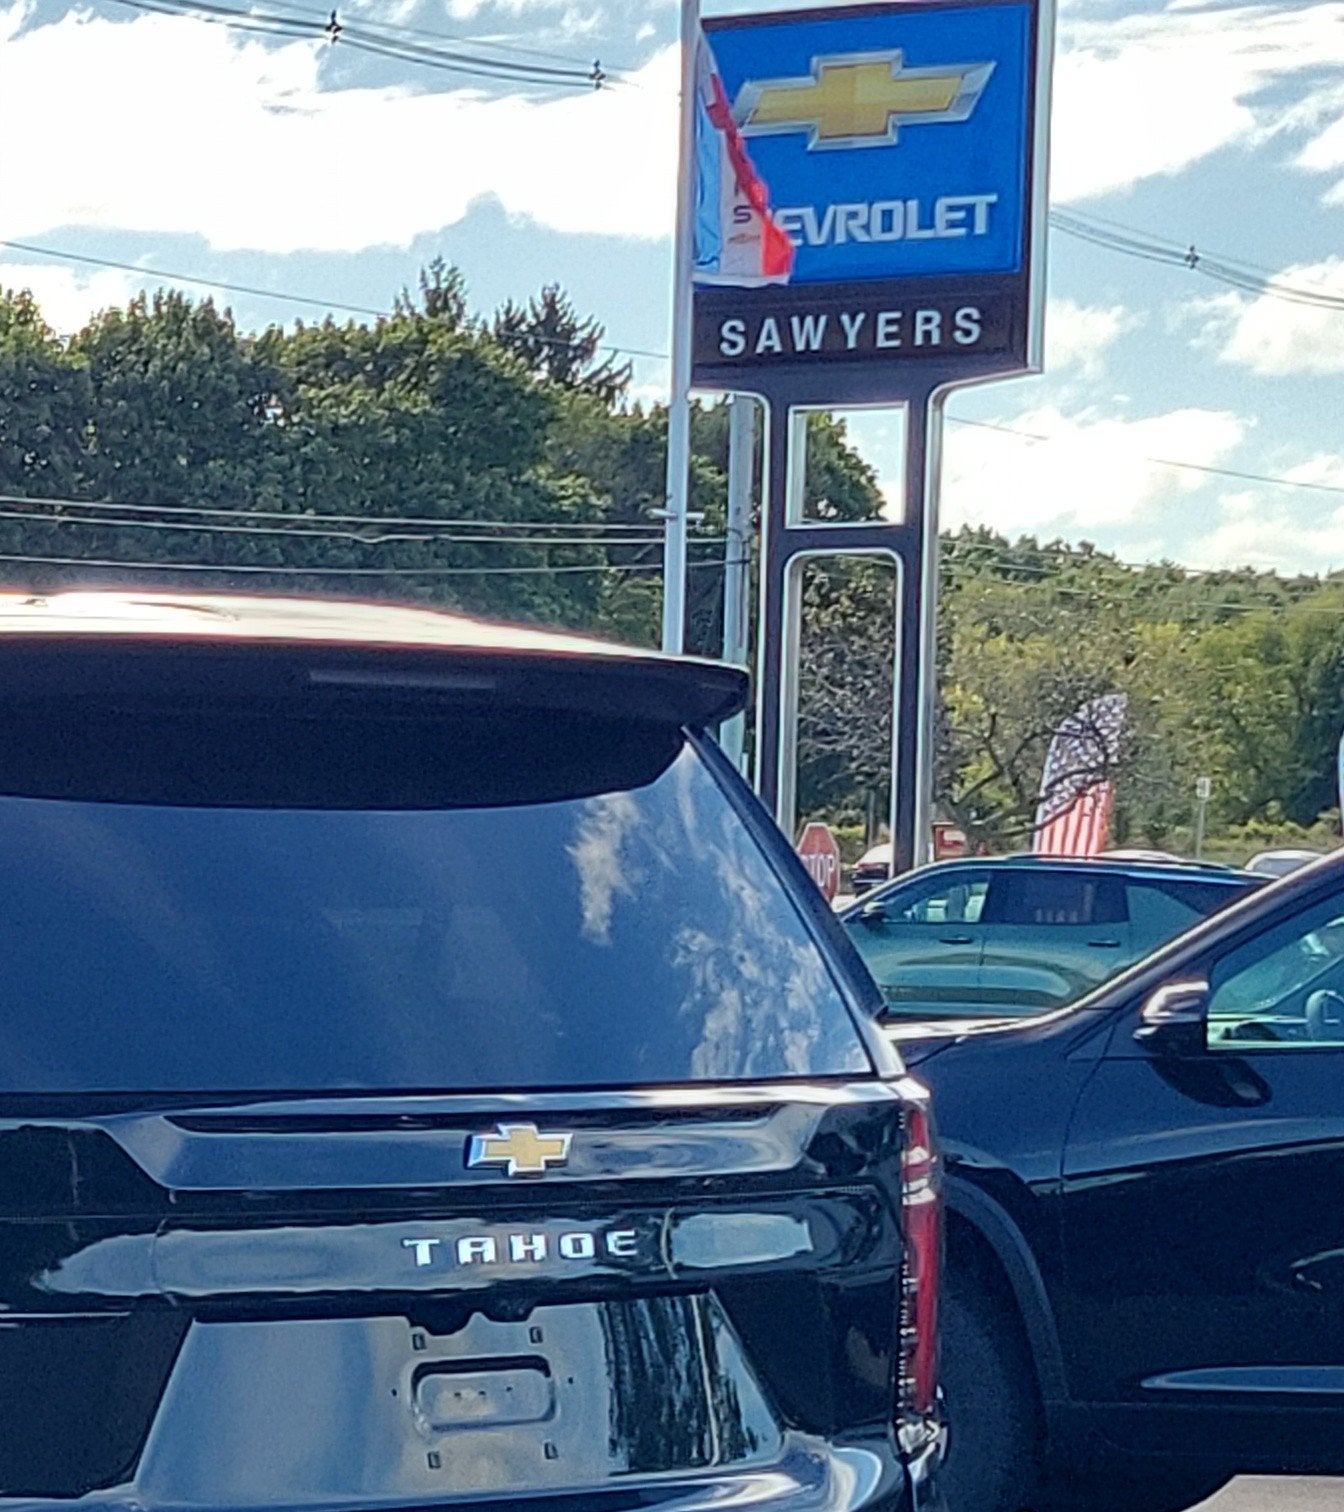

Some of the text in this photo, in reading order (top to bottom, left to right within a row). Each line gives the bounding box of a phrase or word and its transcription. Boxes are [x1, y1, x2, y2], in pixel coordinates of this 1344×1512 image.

[767, 193, 998, 247] EVROLET
[719, 307, 982, 356] SAWYERS
[402, 1229, 638, 1267] TAHOE
